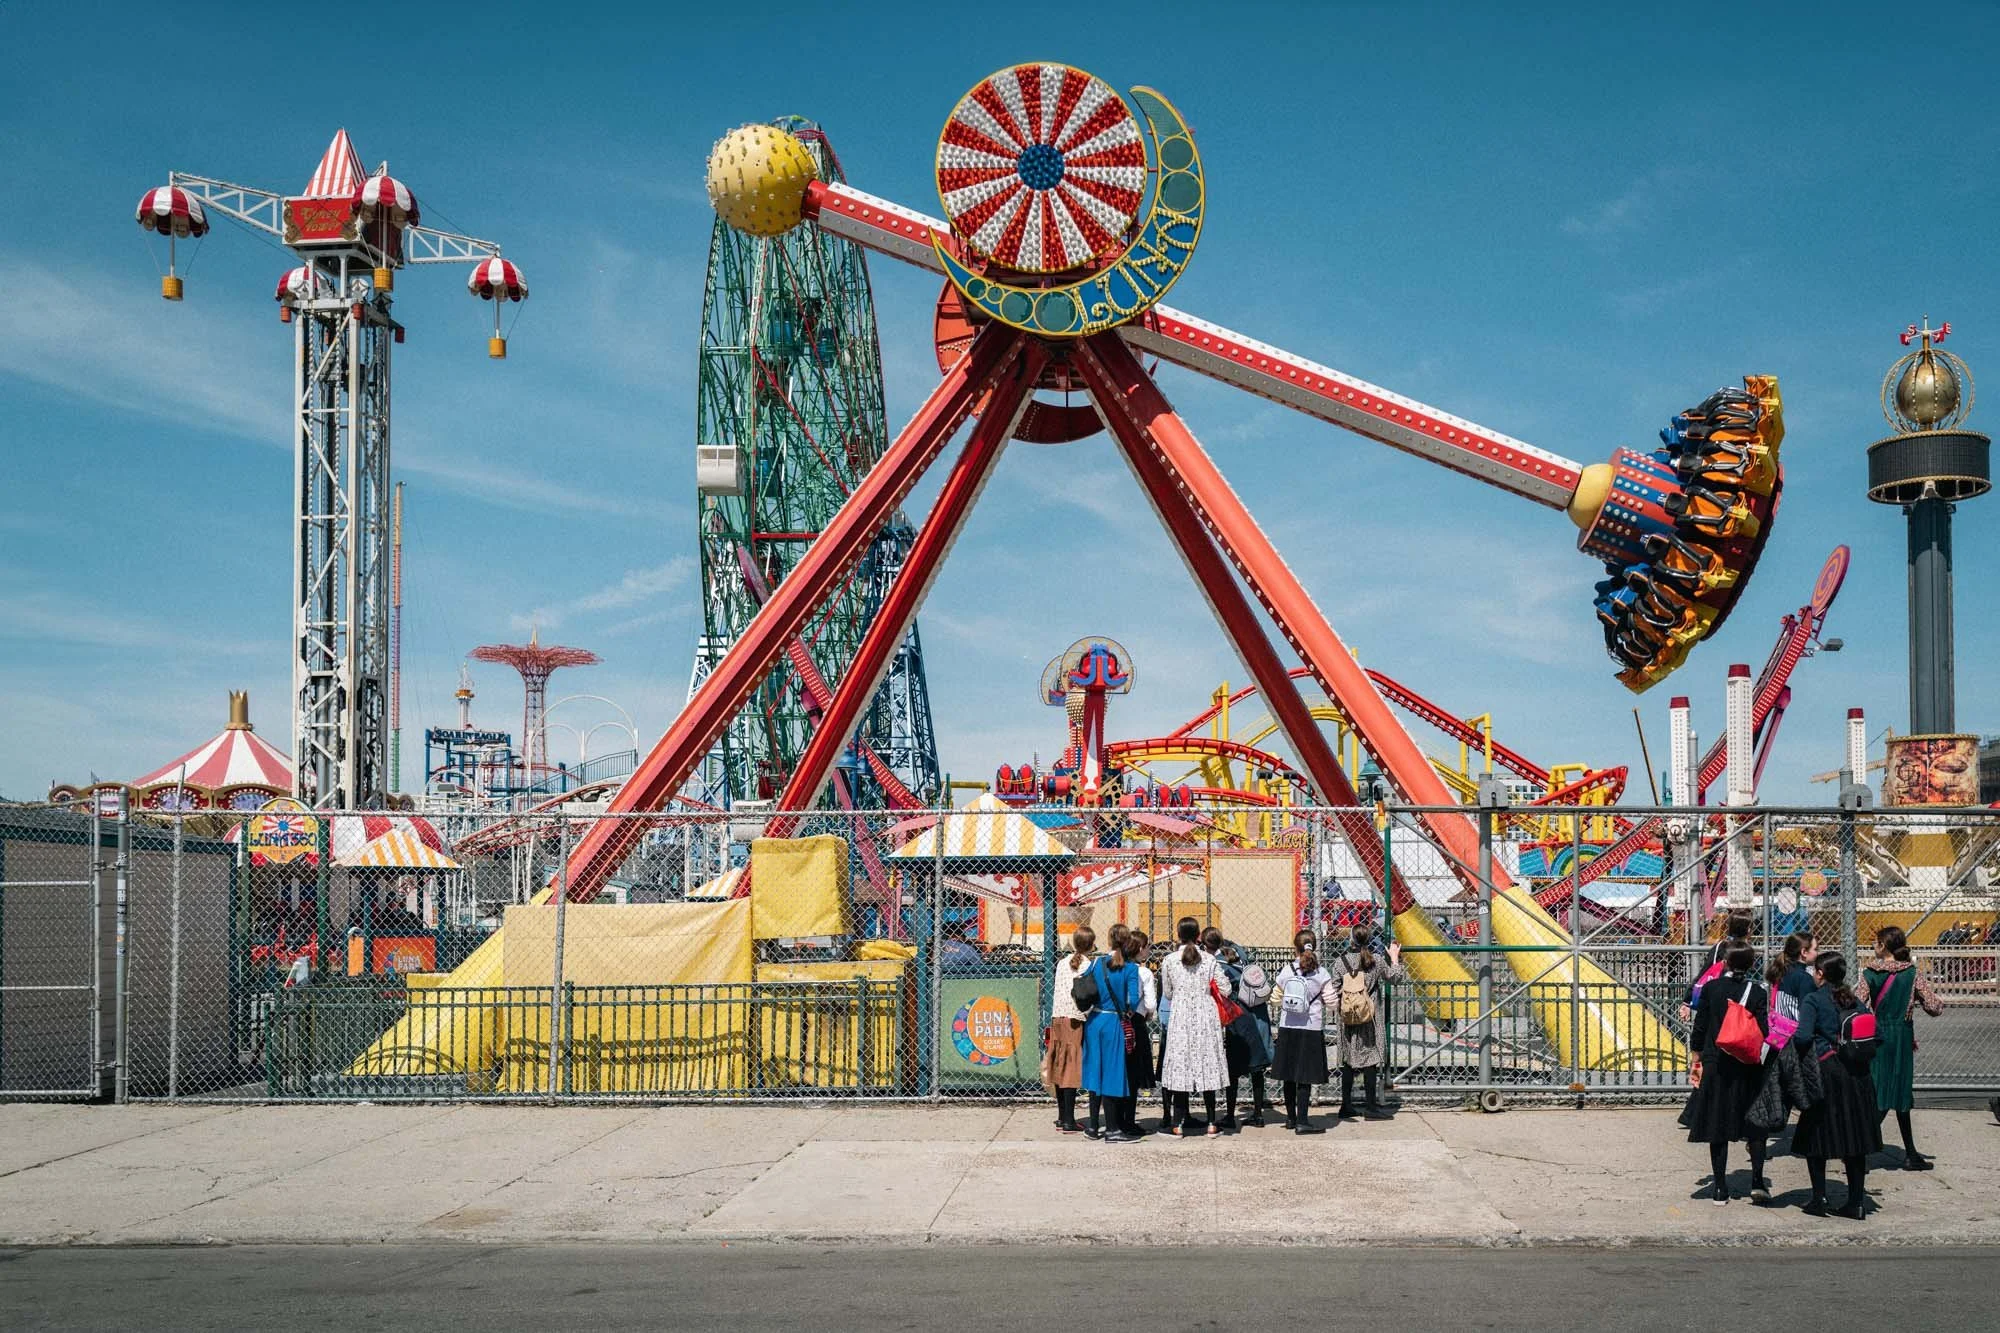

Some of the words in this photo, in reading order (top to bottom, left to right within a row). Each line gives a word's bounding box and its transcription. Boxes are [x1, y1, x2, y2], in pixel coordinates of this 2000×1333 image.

[1072, 207, 1199, 334] LUNA
[975, 1012, 1012, 1024] LUNA
[975, 1025, 1012, 1037] PARK
